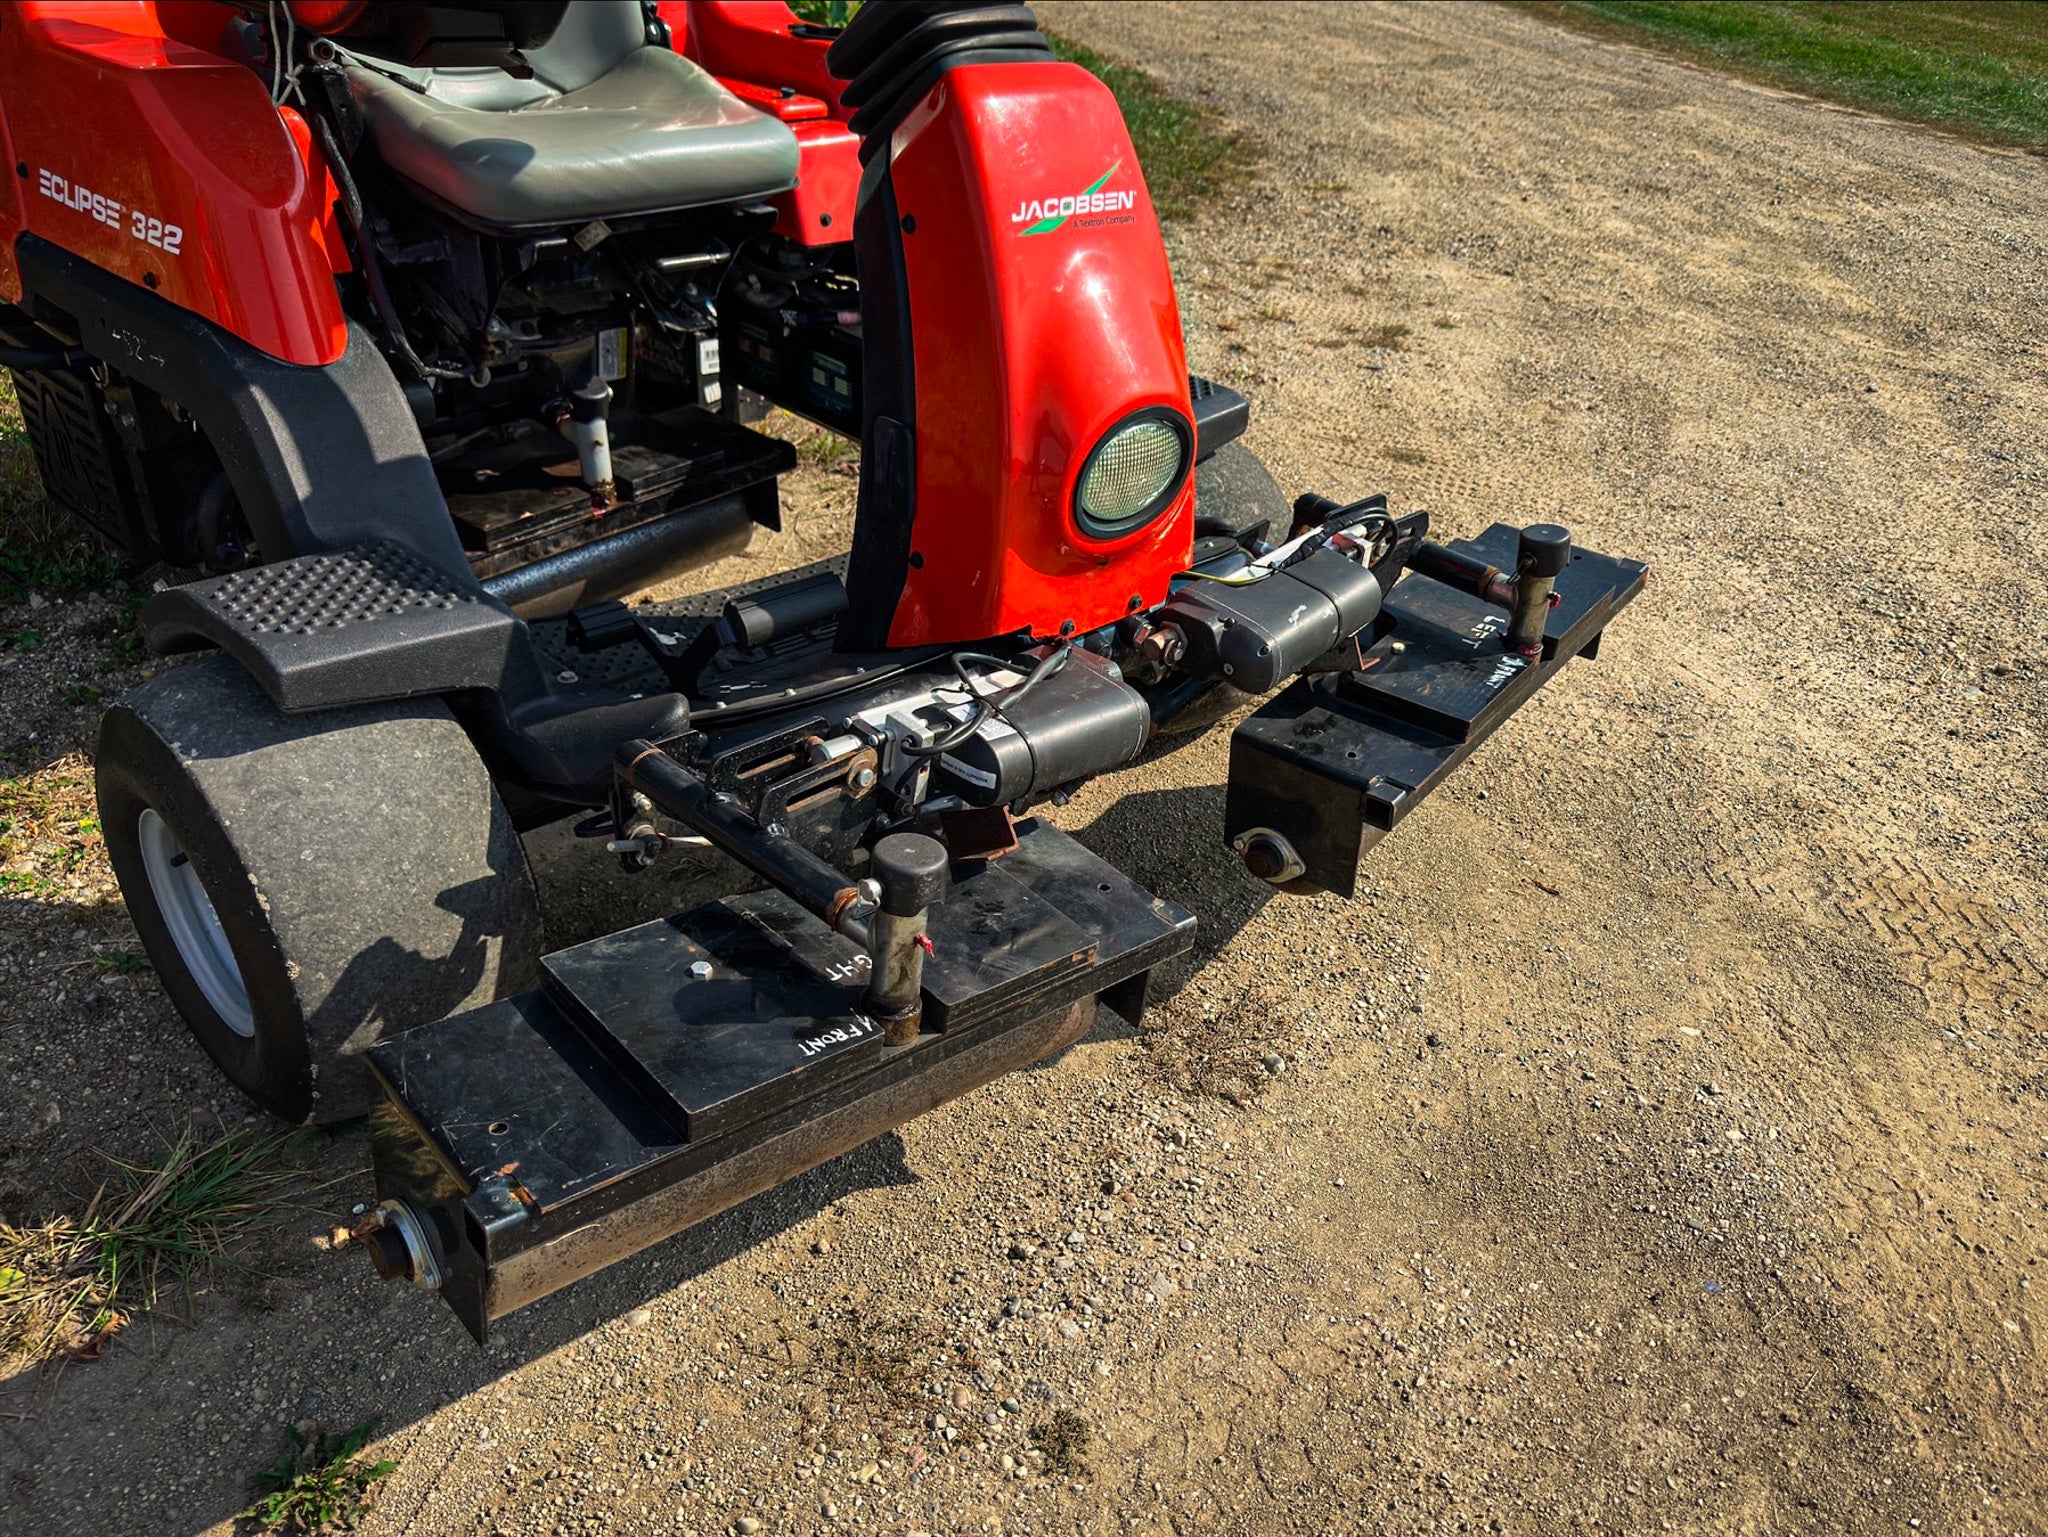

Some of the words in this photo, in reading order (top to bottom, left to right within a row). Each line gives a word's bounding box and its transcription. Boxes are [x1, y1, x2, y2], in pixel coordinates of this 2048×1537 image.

[39, 168, 121, 230] ECLIPSE
[132, 210, 183, 255] 322
[1011, 190, 1135, 222] JACOBSEN
[1073, 220, 1079, 229] A
[1080, 216, 1105, 228] Textron
[1106, 214, 1135, 224] Company
[1461, 615, 1506, 650] LEFT
[825, 954, 873, 981] GHT
[798, 1023, 863, 1056] FRONT
